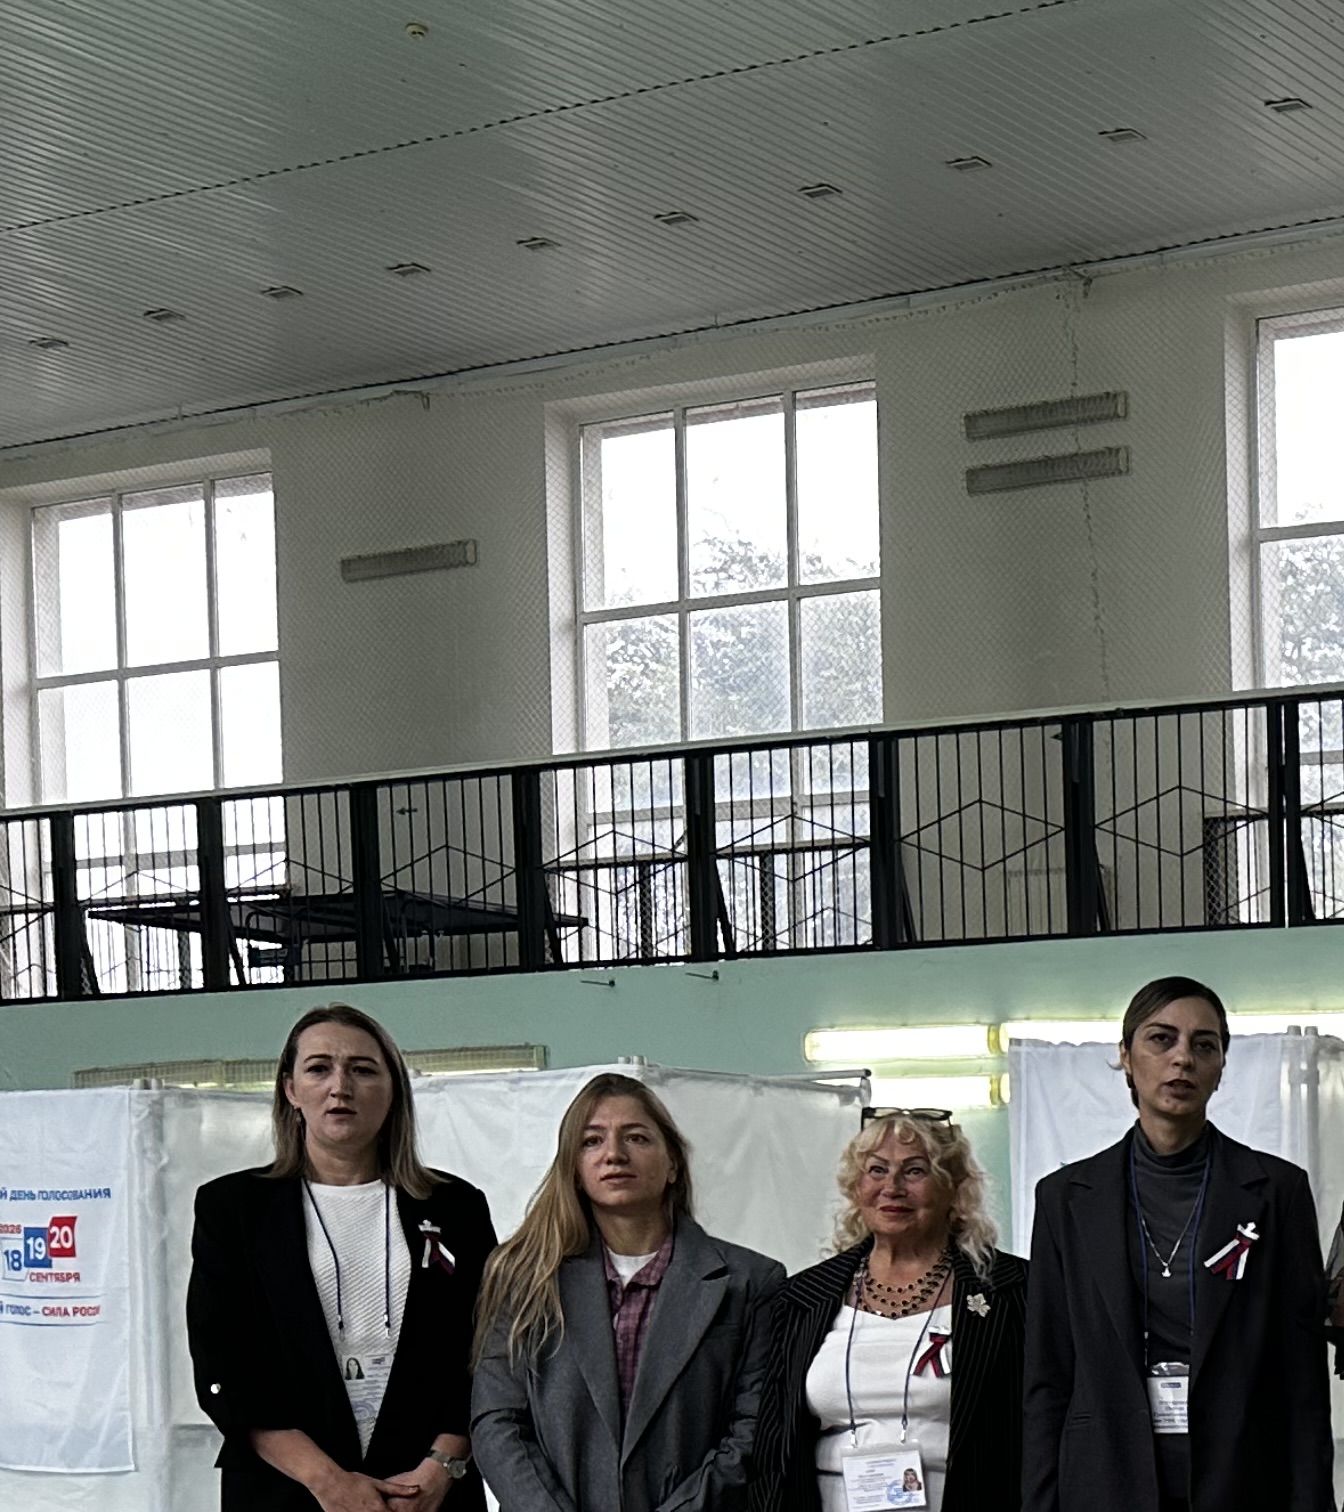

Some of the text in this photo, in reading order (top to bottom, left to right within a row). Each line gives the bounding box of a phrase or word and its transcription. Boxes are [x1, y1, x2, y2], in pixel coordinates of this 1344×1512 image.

[10, 1190, 36, 1202] ДЕНЬ
[37, 1187, 112, 1202] ГОЛОСОВАНИЯ
[50, 1226, 73, 1249] 20
[27, 1236, 47, 1260] 19
[4, 1249, 22, 1272] 18
[29, 1272, 81, 1283] СЕНТЯБРЯ
[42, 1306, 71, 1318] СИЛА
